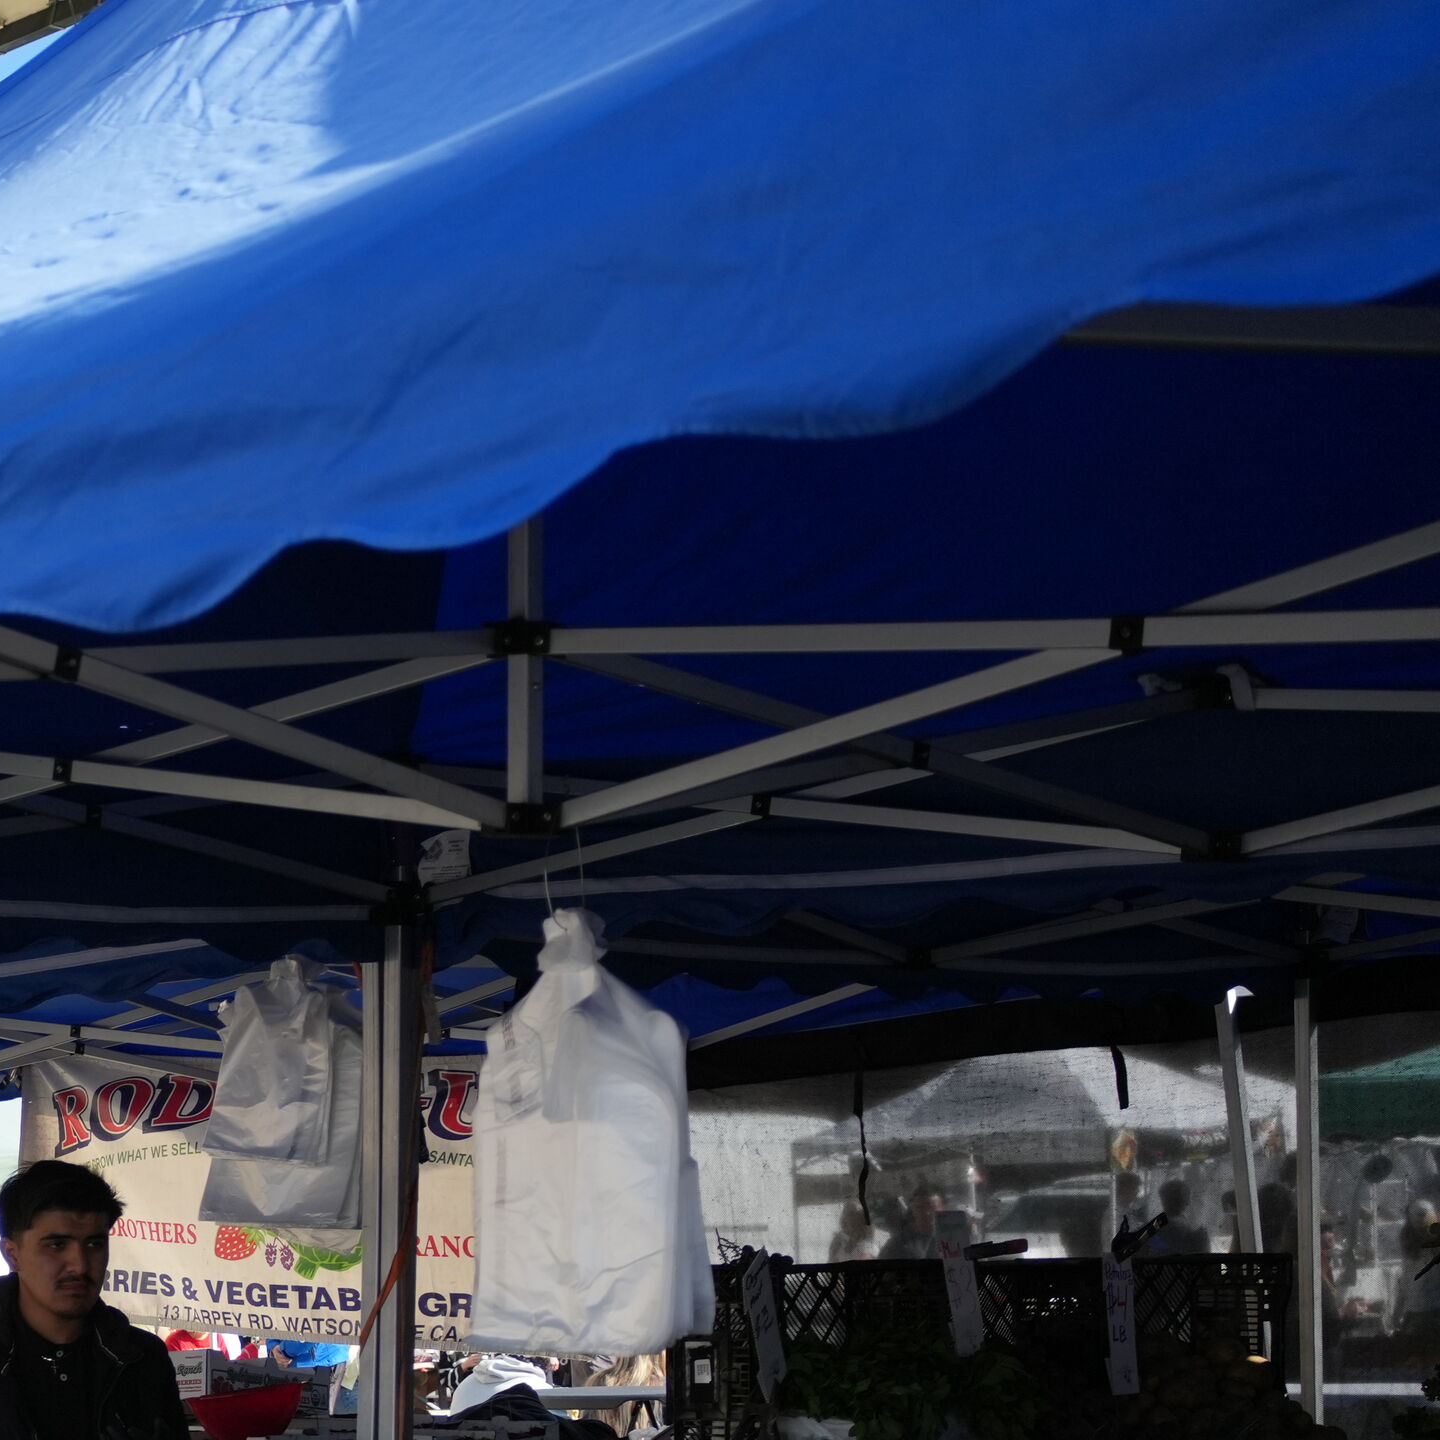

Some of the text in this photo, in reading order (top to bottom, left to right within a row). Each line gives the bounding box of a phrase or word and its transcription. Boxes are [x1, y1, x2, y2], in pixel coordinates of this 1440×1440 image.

[117, 1147, 148, 1165] WHAT
[150, 1144, 168, 1158] WE
[171, 1141, 201, 1156] SELL
[429, 1150, 474, 1168] SANTA
[416, 1235, 476, 1258] RANC
[181, 1277, 200, 1302] &
[204, 1279, 362, 1312] VEGETAB
[418, 1292, 473, 1319] GR
[183, 1306, 242, 1328] TARPEY
[176, 1362, 203, 1376] Ranch
